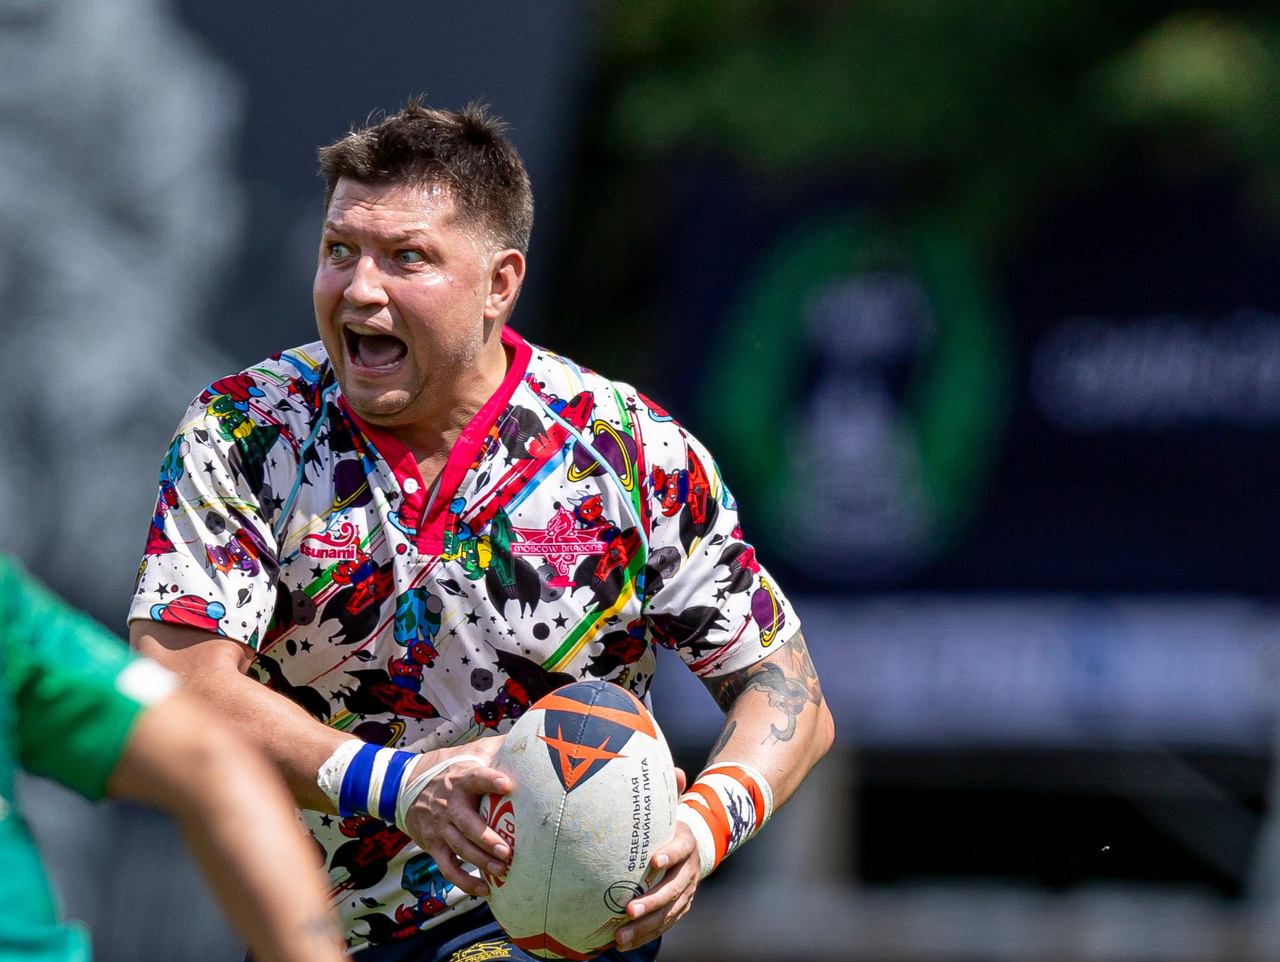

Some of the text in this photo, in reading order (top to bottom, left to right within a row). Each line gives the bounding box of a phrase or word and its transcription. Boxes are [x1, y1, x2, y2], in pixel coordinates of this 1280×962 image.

[300, 542, 355, 559] tsunami
[514, 544, 603, 553] MOSCOW DRAGONS
[628, 777, 641, 872] ФЕДЕРАЛЬНАЯ
[639, 757, 652, 870] РЕГБИЙНАЯ ЛИГА
